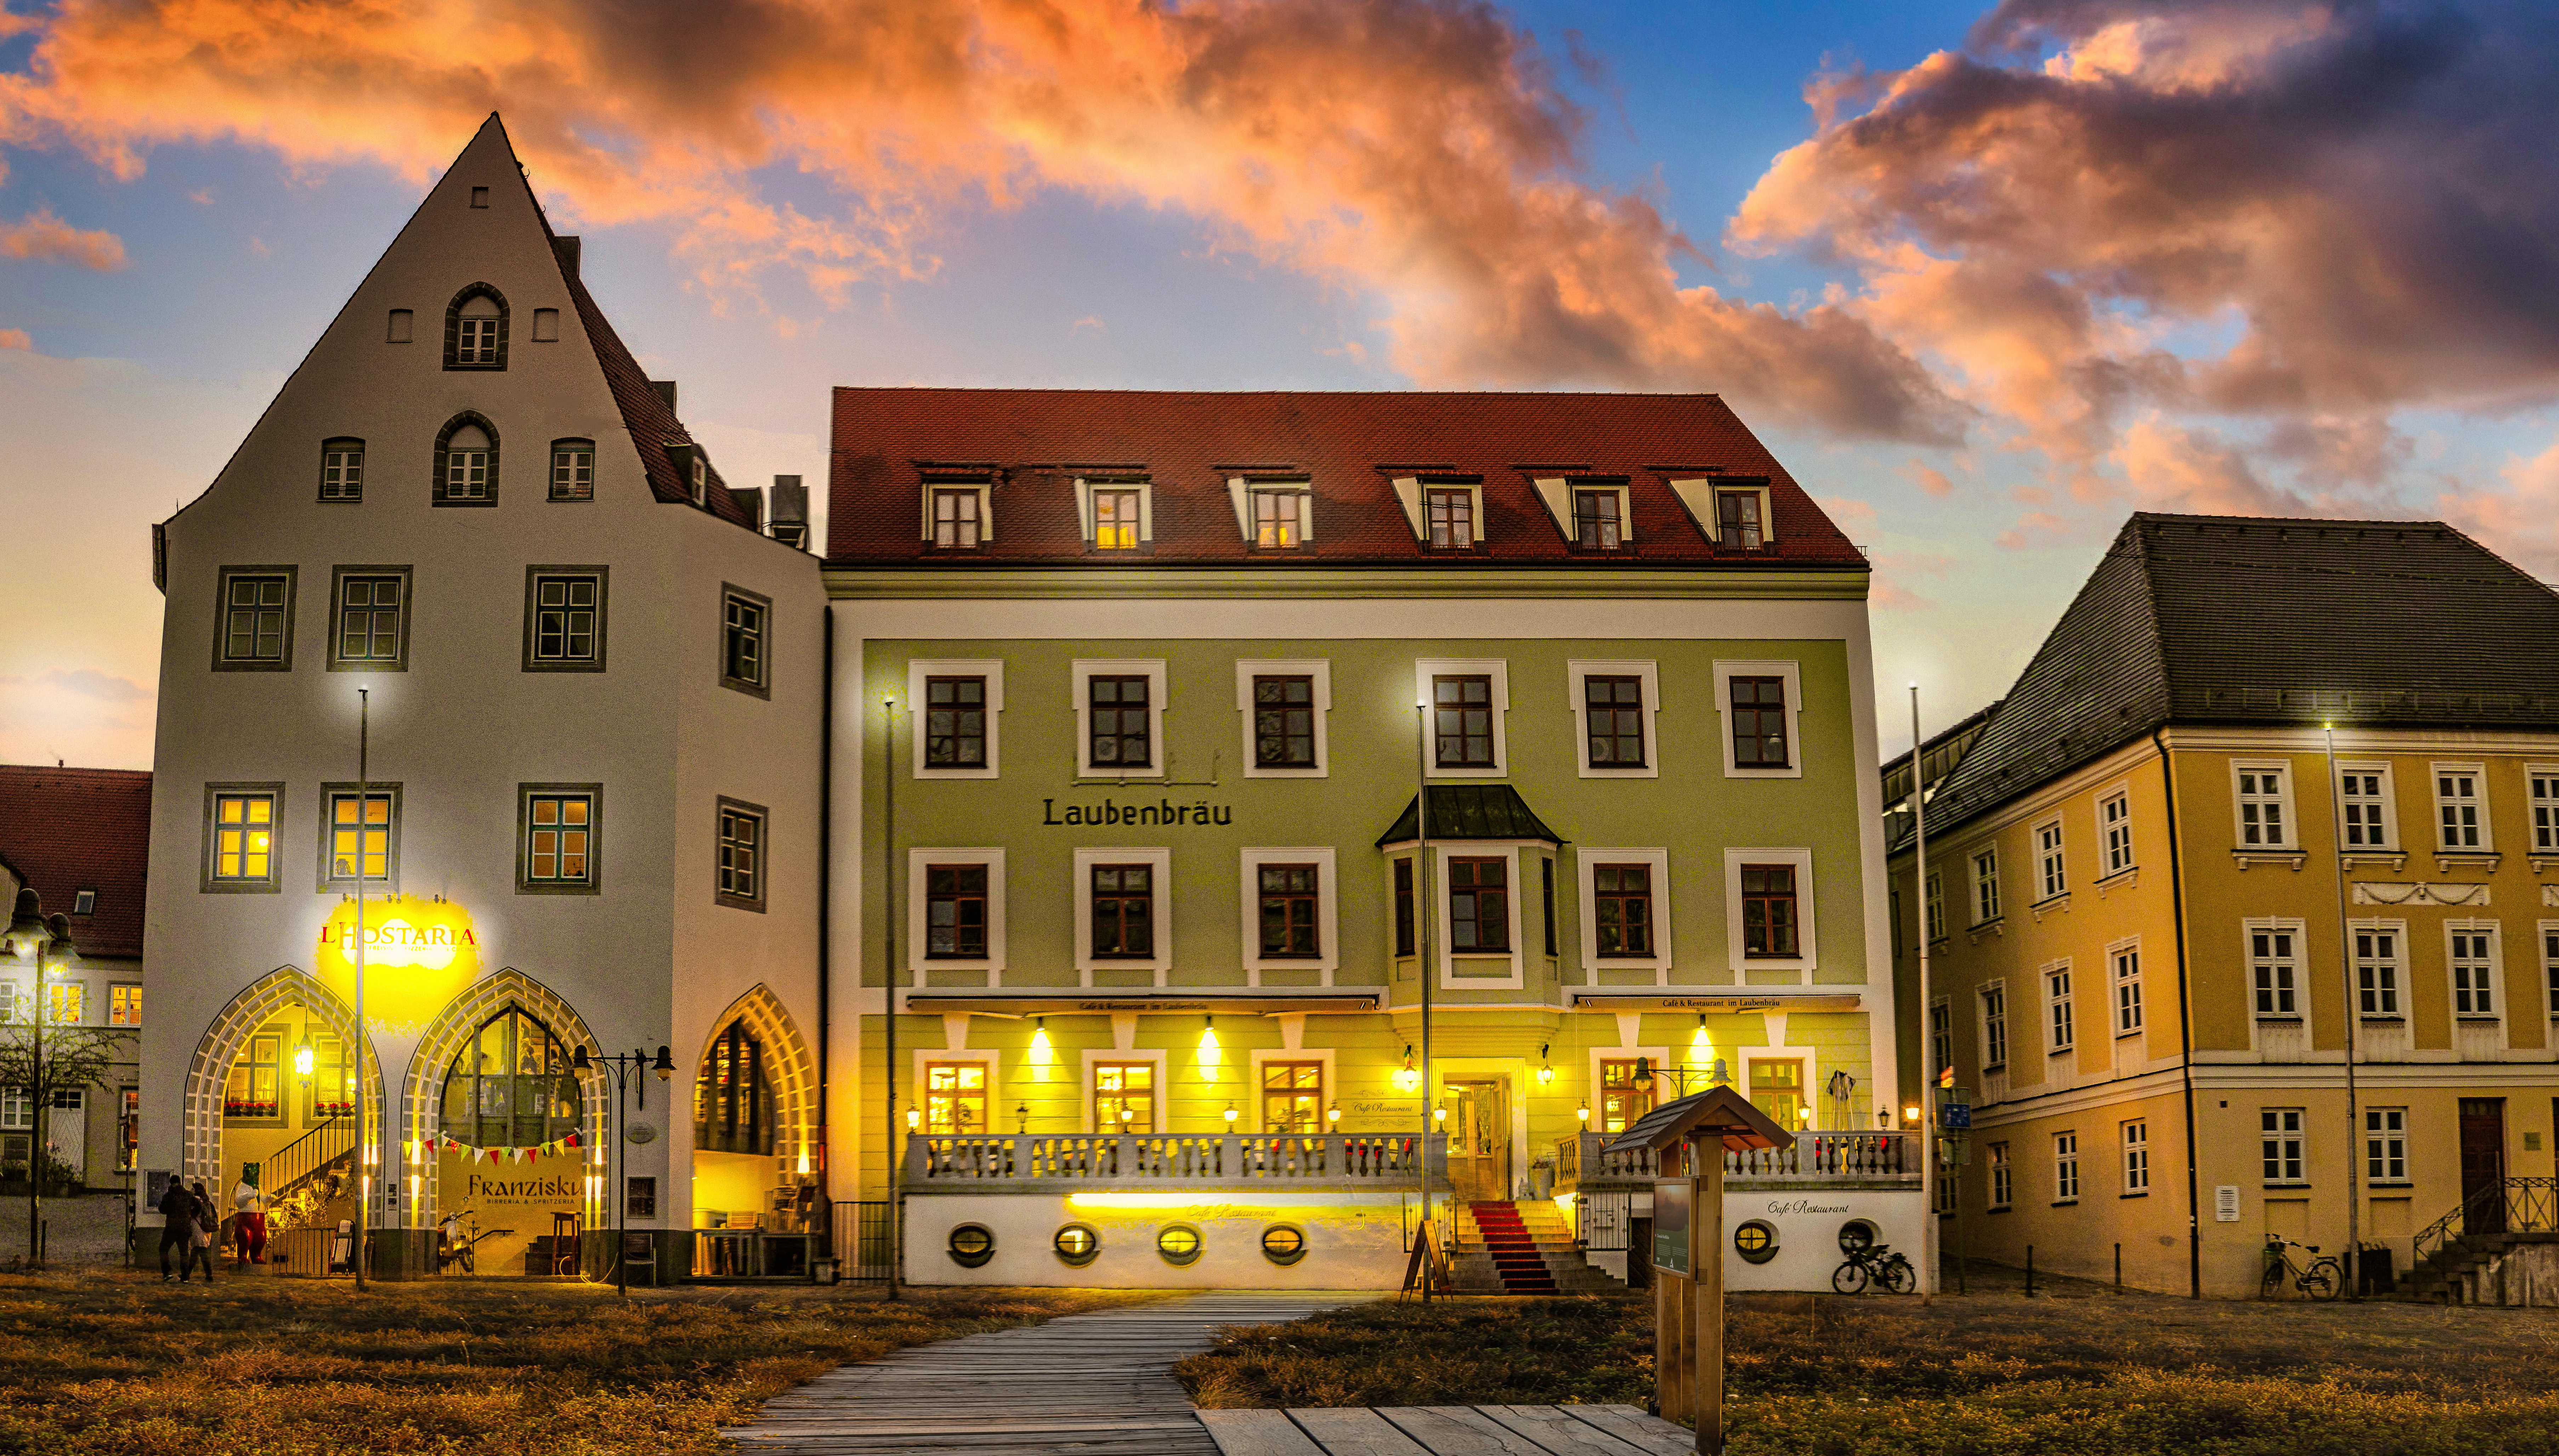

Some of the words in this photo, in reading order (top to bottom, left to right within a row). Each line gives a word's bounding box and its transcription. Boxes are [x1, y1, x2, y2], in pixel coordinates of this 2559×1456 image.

[1043, 798, 1233, 826] Laubenbräu
[1353, 1102, 1372, 1114] Café
[1372, 1103, 1413, 1112] Restaurant
[1767, 1200, 1792, 1217] Café
[1793, 1199, 1849, 1214] Restaurant
